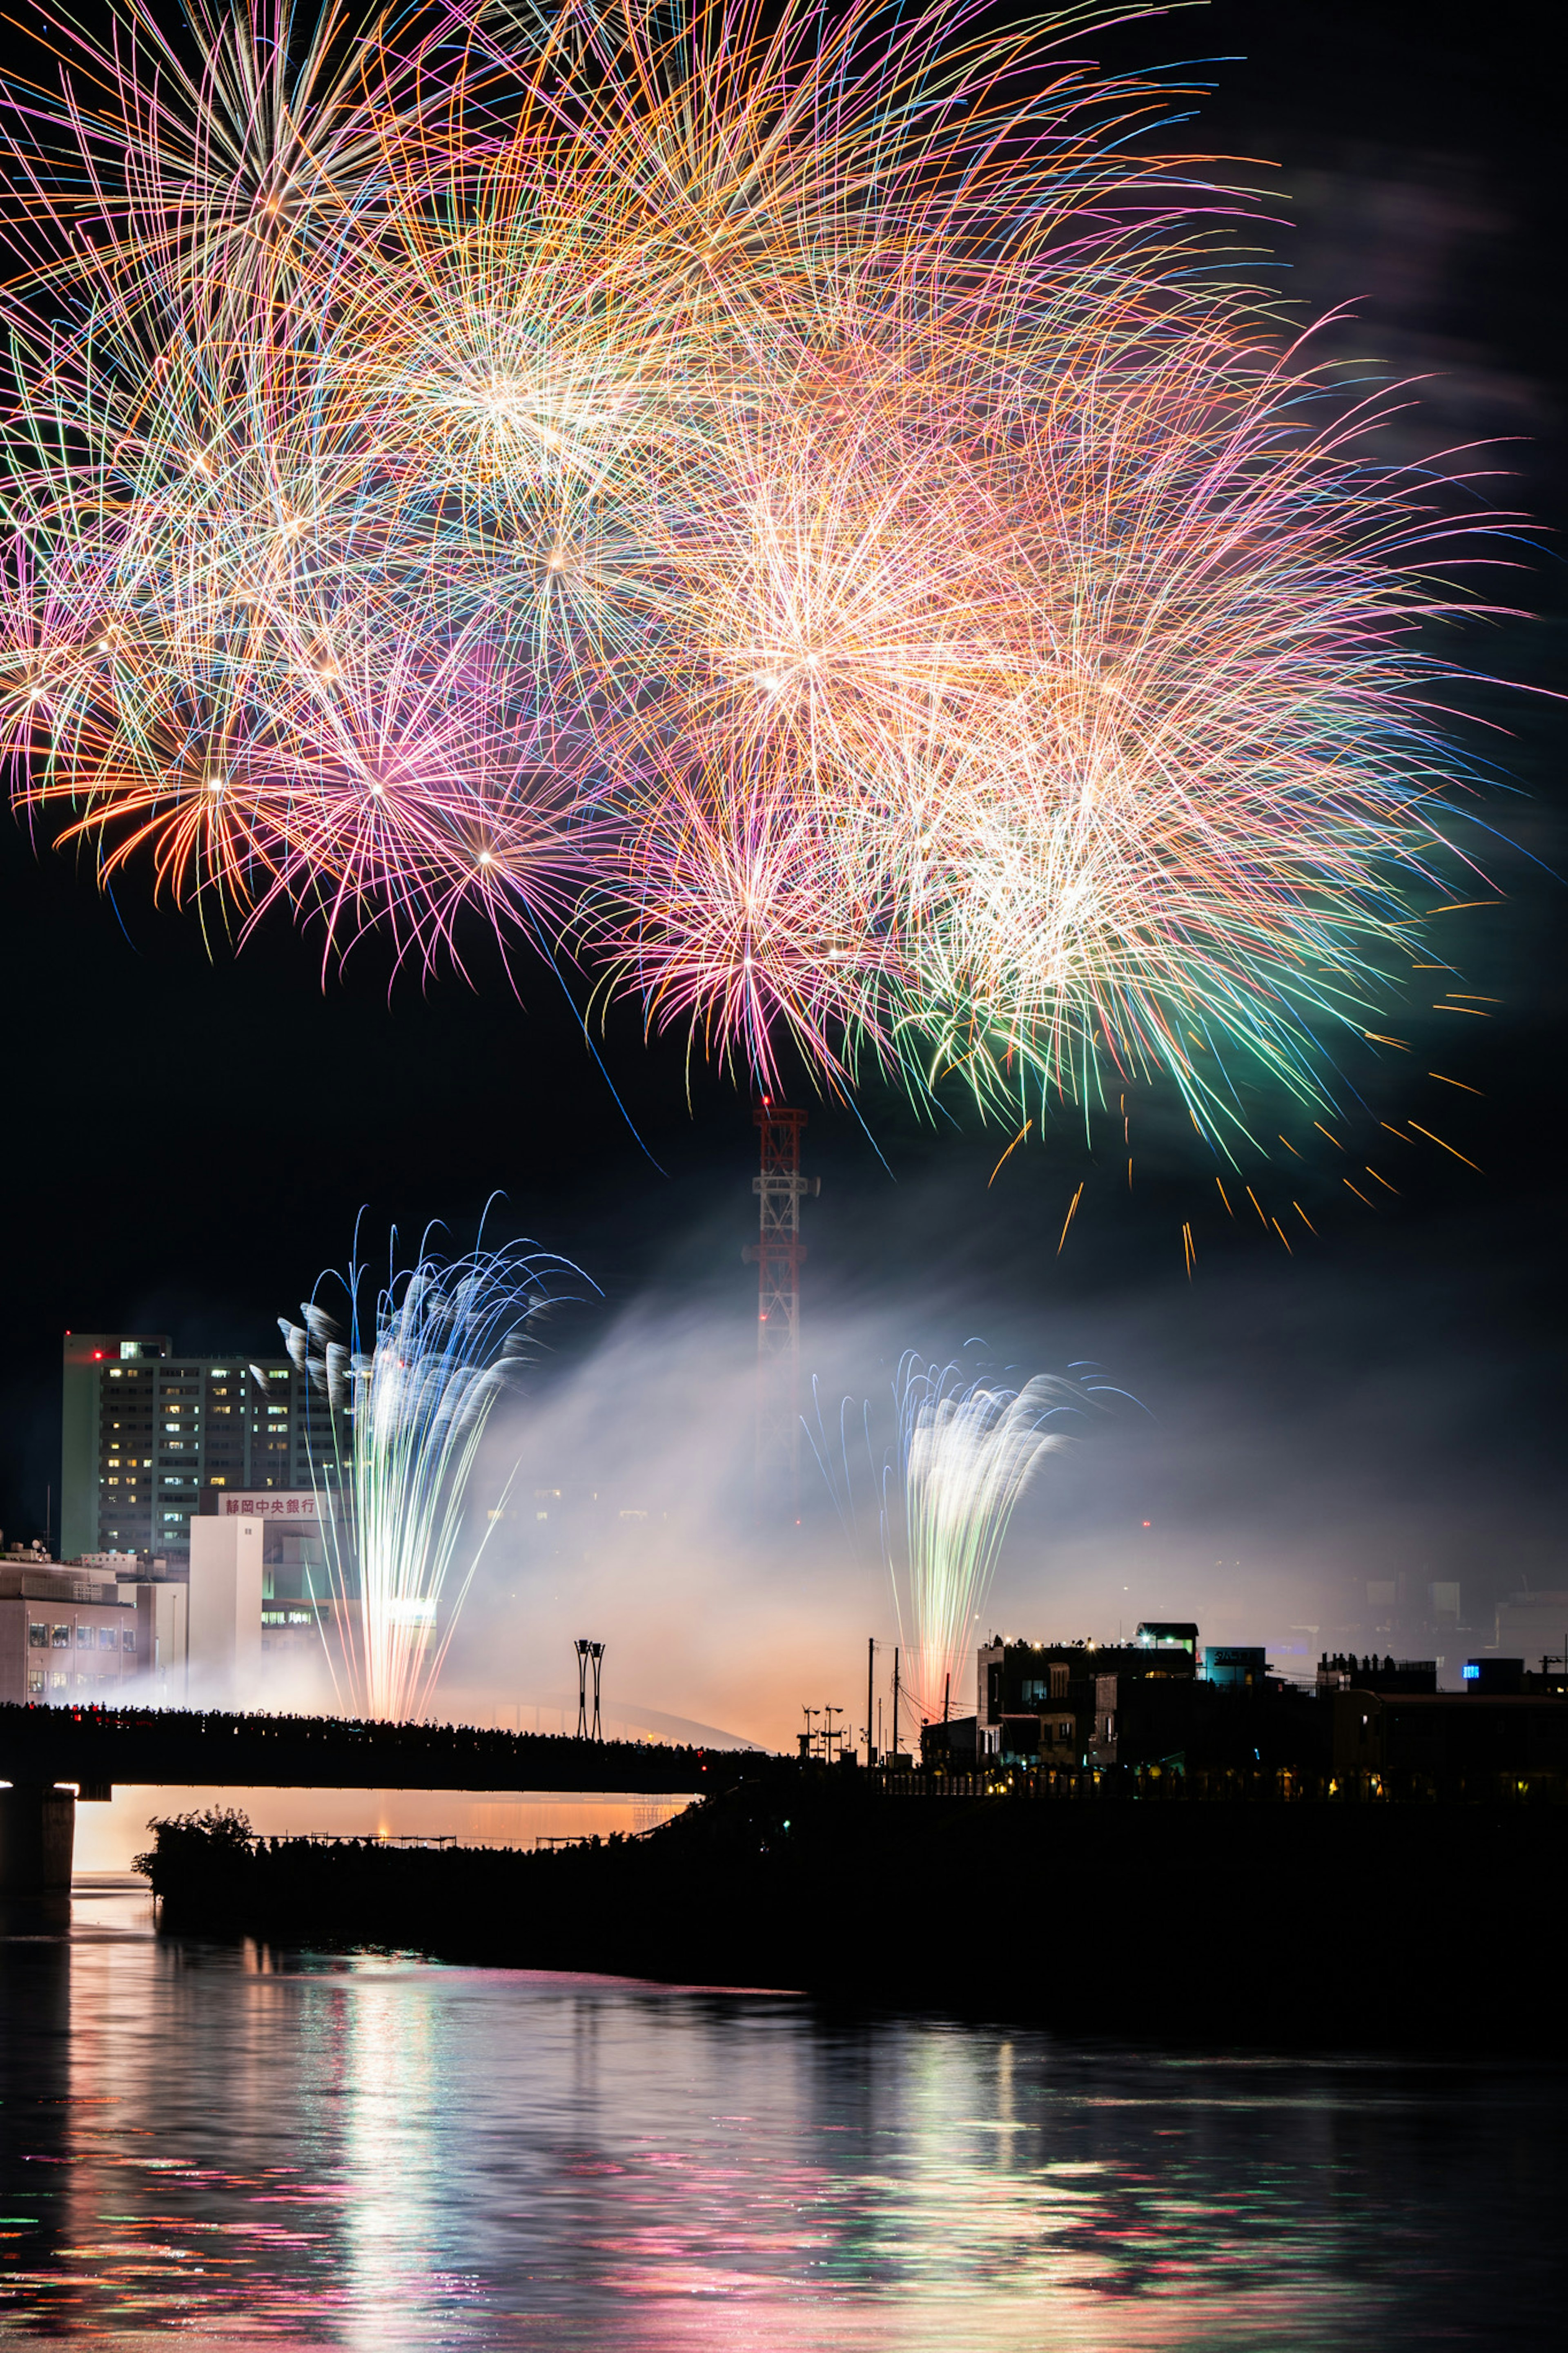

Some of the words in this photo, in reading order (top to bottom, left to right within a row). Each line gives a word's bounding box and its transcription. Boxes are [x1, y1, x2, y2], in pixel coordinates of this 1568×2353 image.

[226, 1499, 314, 1514] 静岡中央銀行
